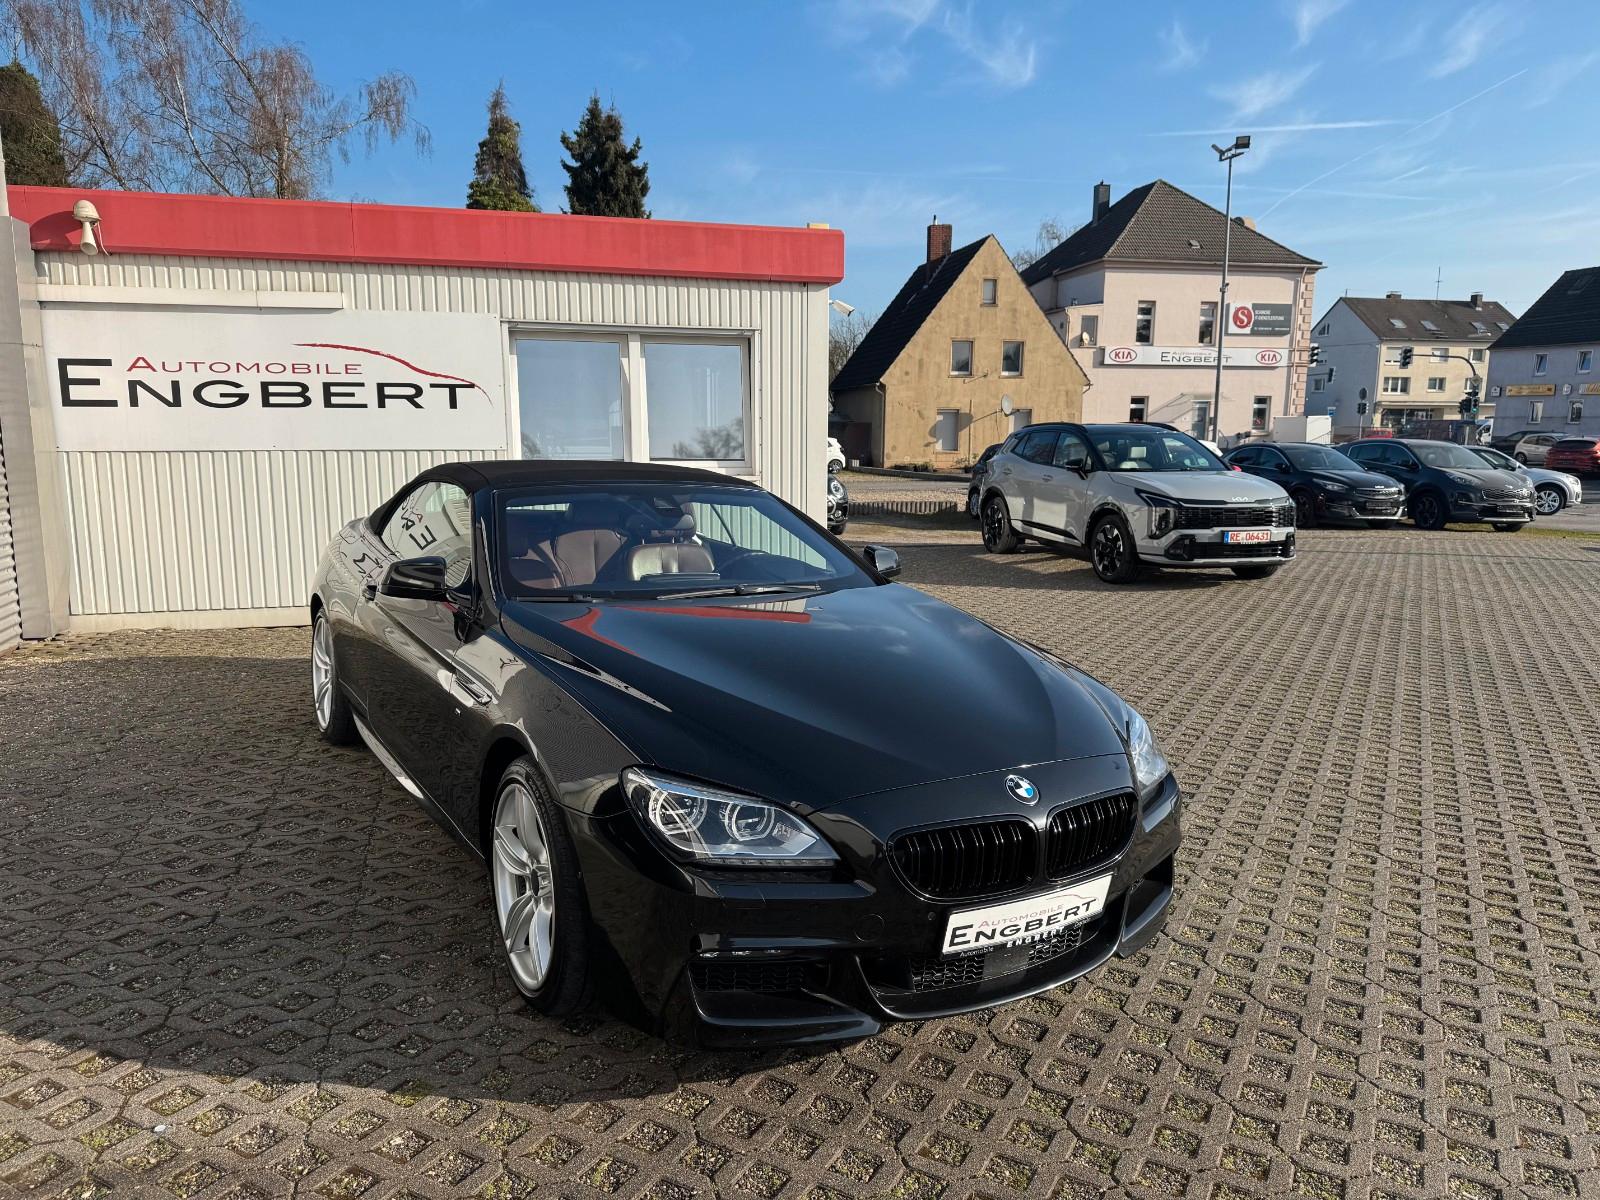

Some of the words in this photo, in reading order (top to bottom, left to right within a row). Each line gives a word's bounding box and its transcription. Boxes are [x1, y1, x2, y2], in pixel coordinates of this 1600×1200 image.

[1114, 351, 1133, 360] KIA
[1260, 353, 1279, 362] KIA
[126, 356, 363, 375] AUTOMOBILE
[57, 357, 476, 410] ENGBERT
[1230, 532, 1241, 541] RE
[948, 898, 1097, 948] ENGBERT
[978, 903, 1064, 929] AUTOMOBILE
